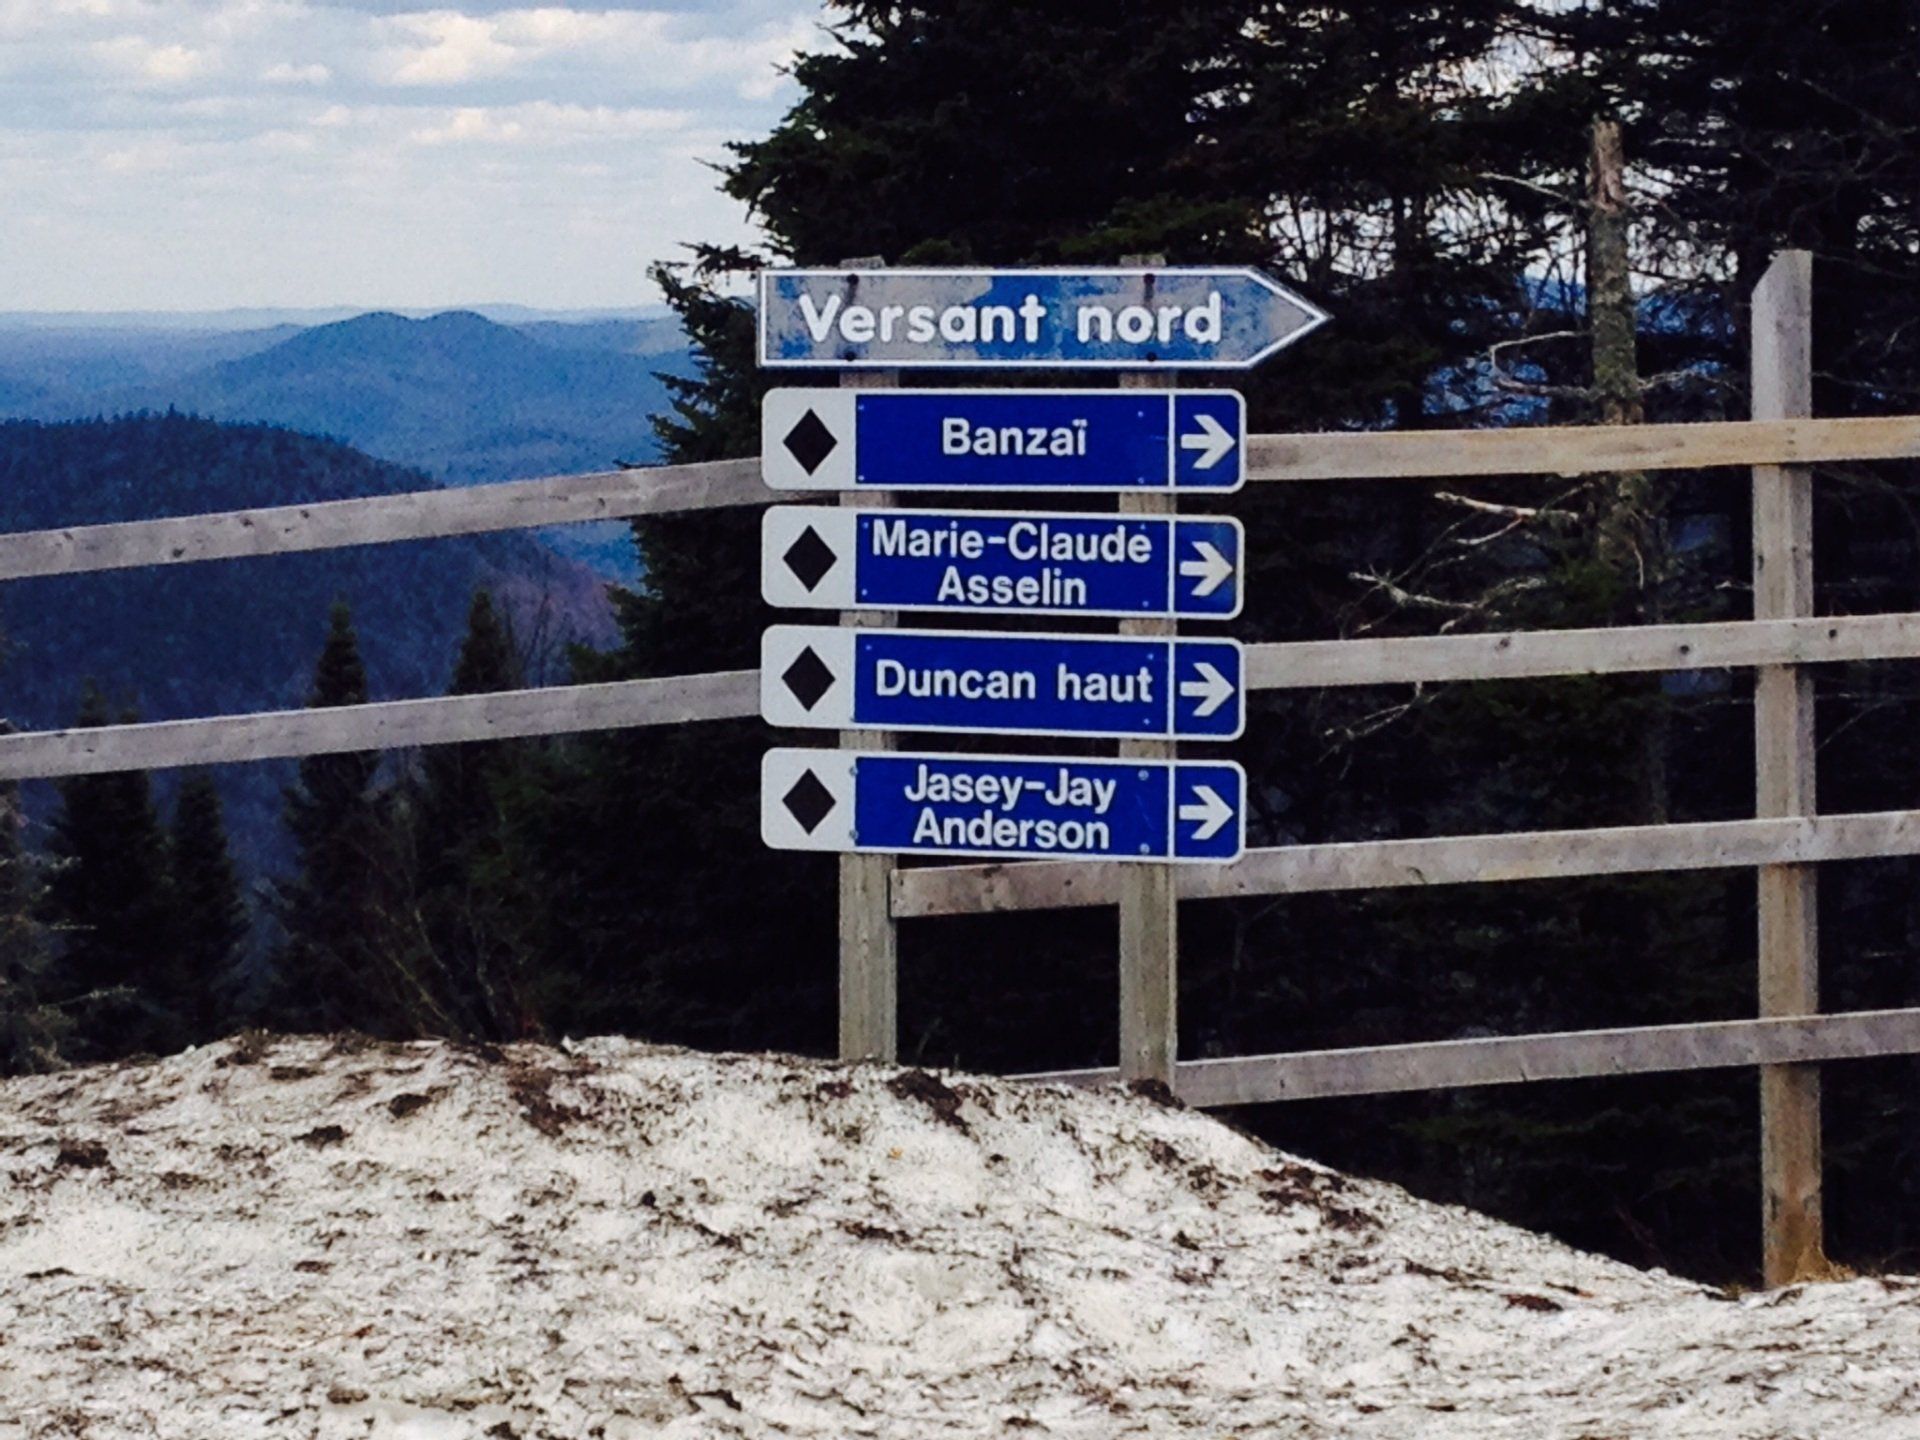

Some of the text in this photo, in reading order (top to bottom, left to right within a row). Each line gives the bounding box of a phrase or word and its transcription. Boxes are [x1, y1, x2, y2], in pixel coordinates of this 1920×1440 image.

[799, 291, 1222, 343] Versant nord
[942, 417, 1088, 456] Banzaï
[872, 518, 1152, 563] Marie-Claude
[937, 565, 1087, 605] Asselin
[876, 659, 1153, 703] Duncan haut
[904, 763, 1116, 814] Jasey-Jay
[913, 807, 1110, 849] Anderson
